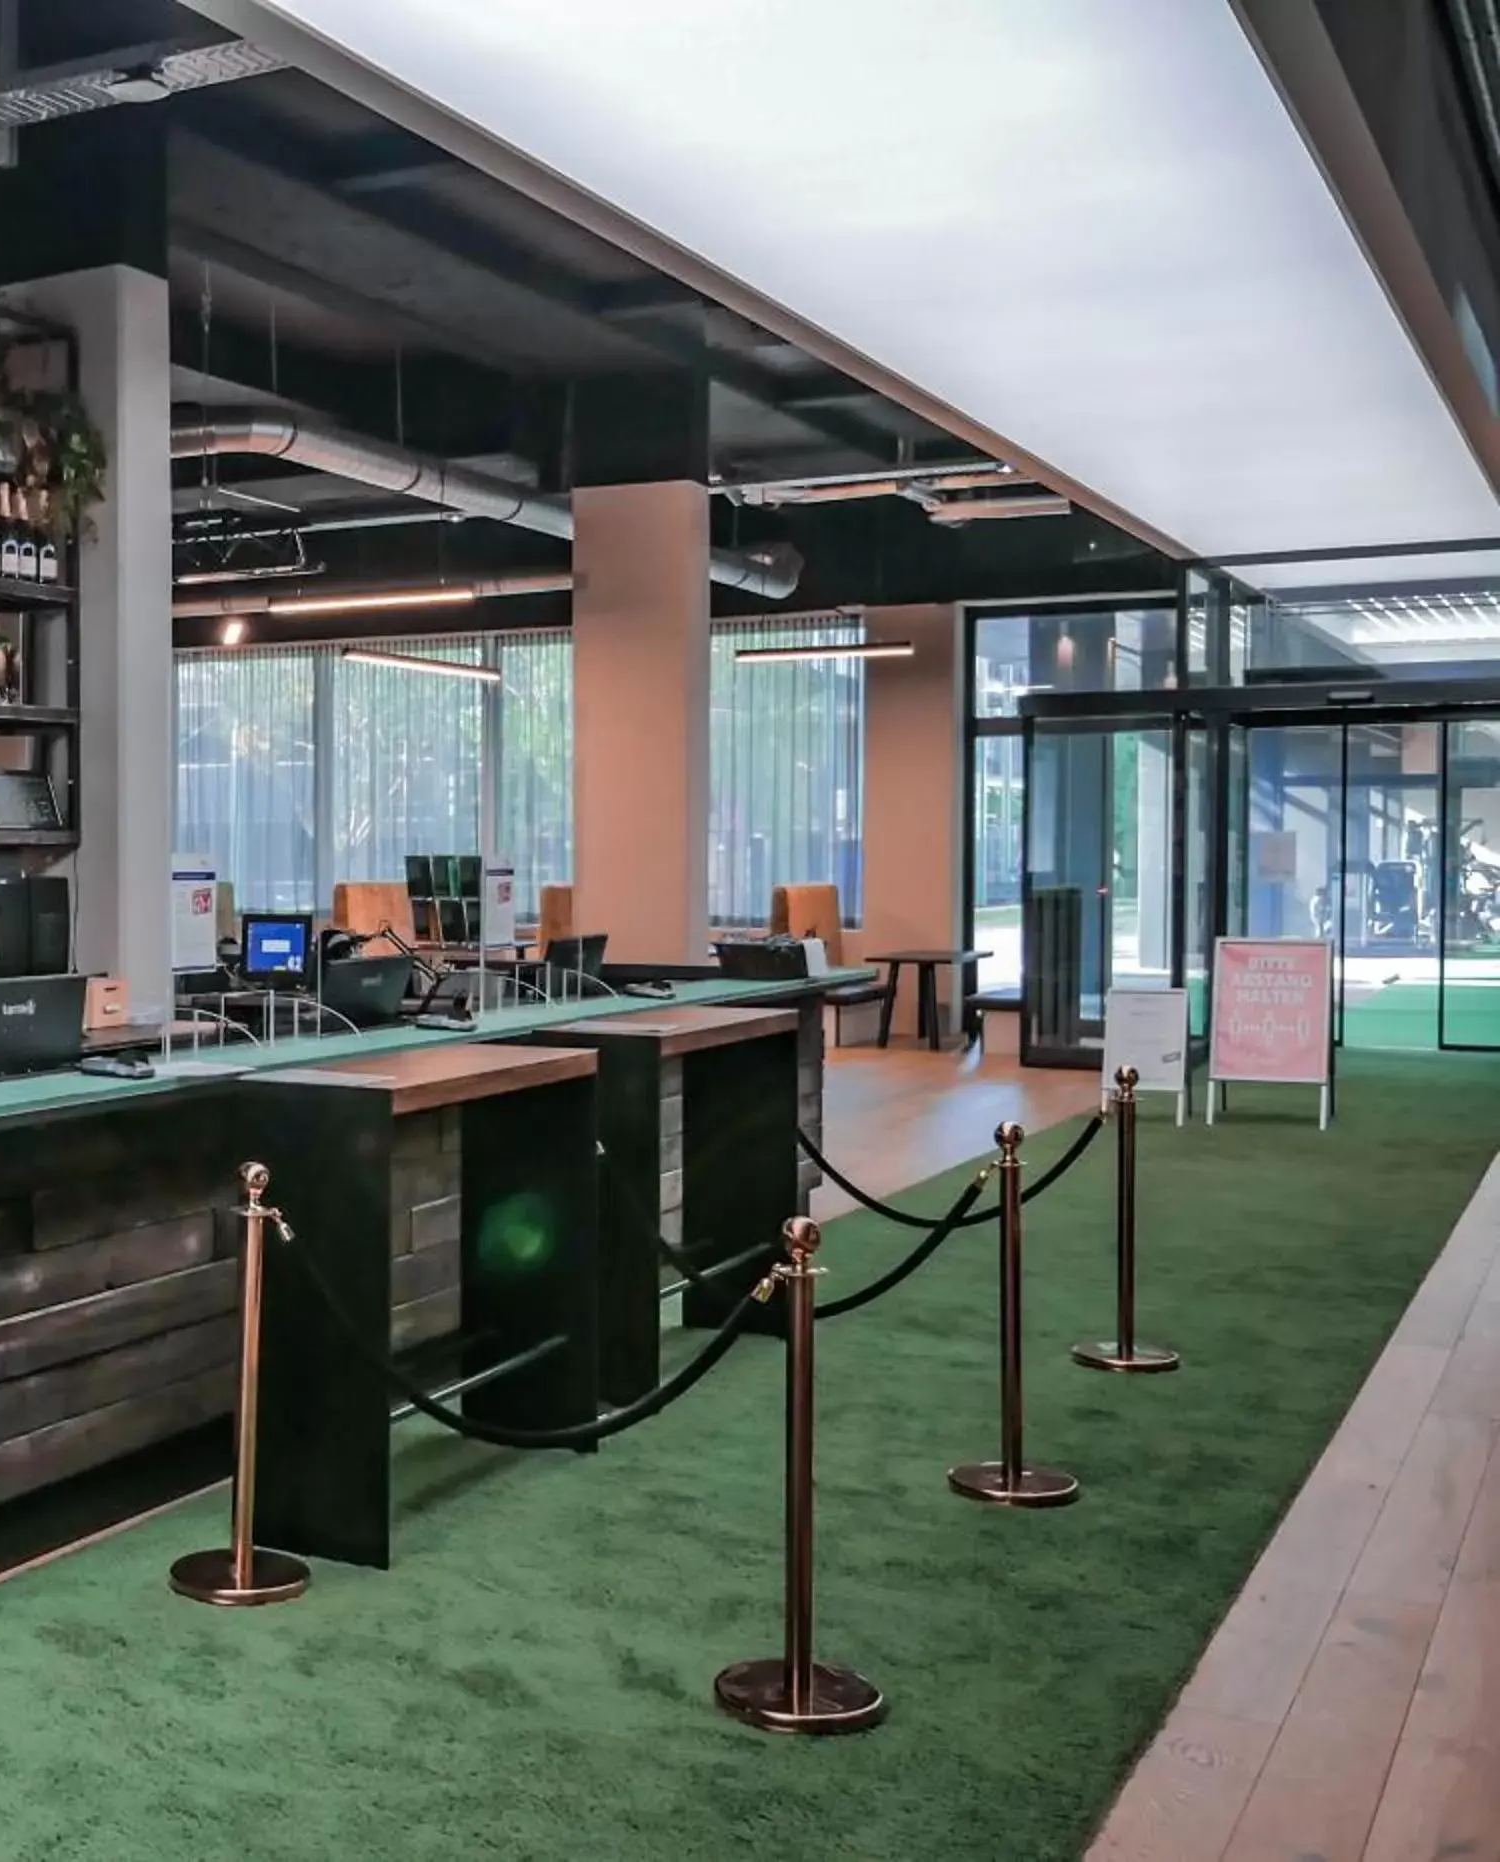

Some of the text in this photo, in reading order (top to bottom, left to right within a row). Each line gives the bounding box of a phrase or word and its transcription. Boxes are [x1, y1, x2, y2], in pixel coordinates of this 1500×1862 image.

[1248, 957, 1295, 971] BITTE
[1231, 972, 1312, 988] ABSTAND
[1236, 989, 1304, 1004] HALTEN
